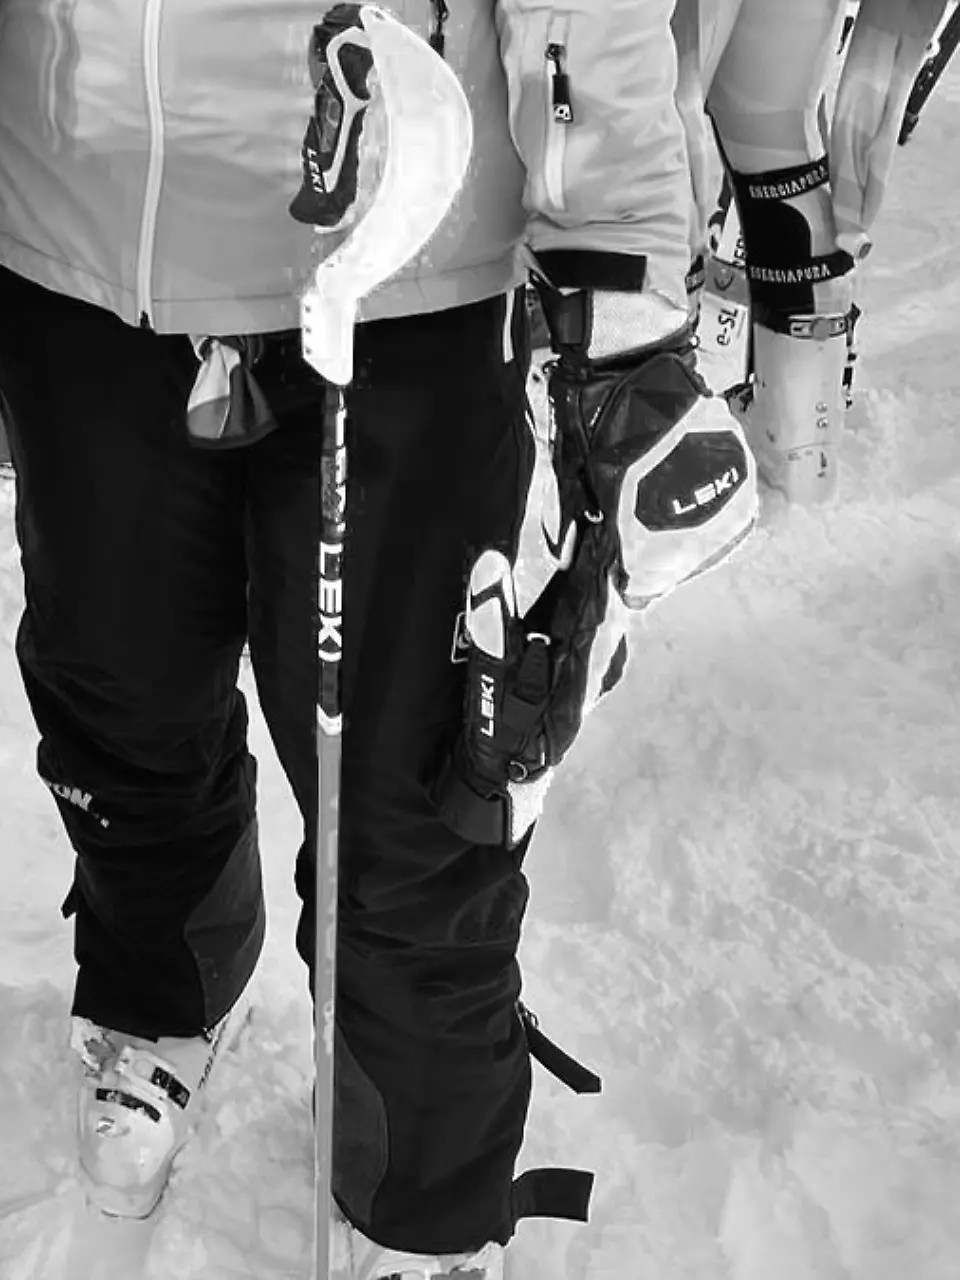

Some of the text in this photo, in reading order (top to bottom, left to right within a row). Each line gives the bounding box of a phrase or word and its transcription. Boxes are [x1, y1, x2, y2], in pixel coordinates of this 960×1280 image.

[306, 147, 325, 193] LEKI
[671, 466, 739, 515] LEKI
[317, 540, 343, 662] LEKI
[480, 673, 495, 738] LEKI
